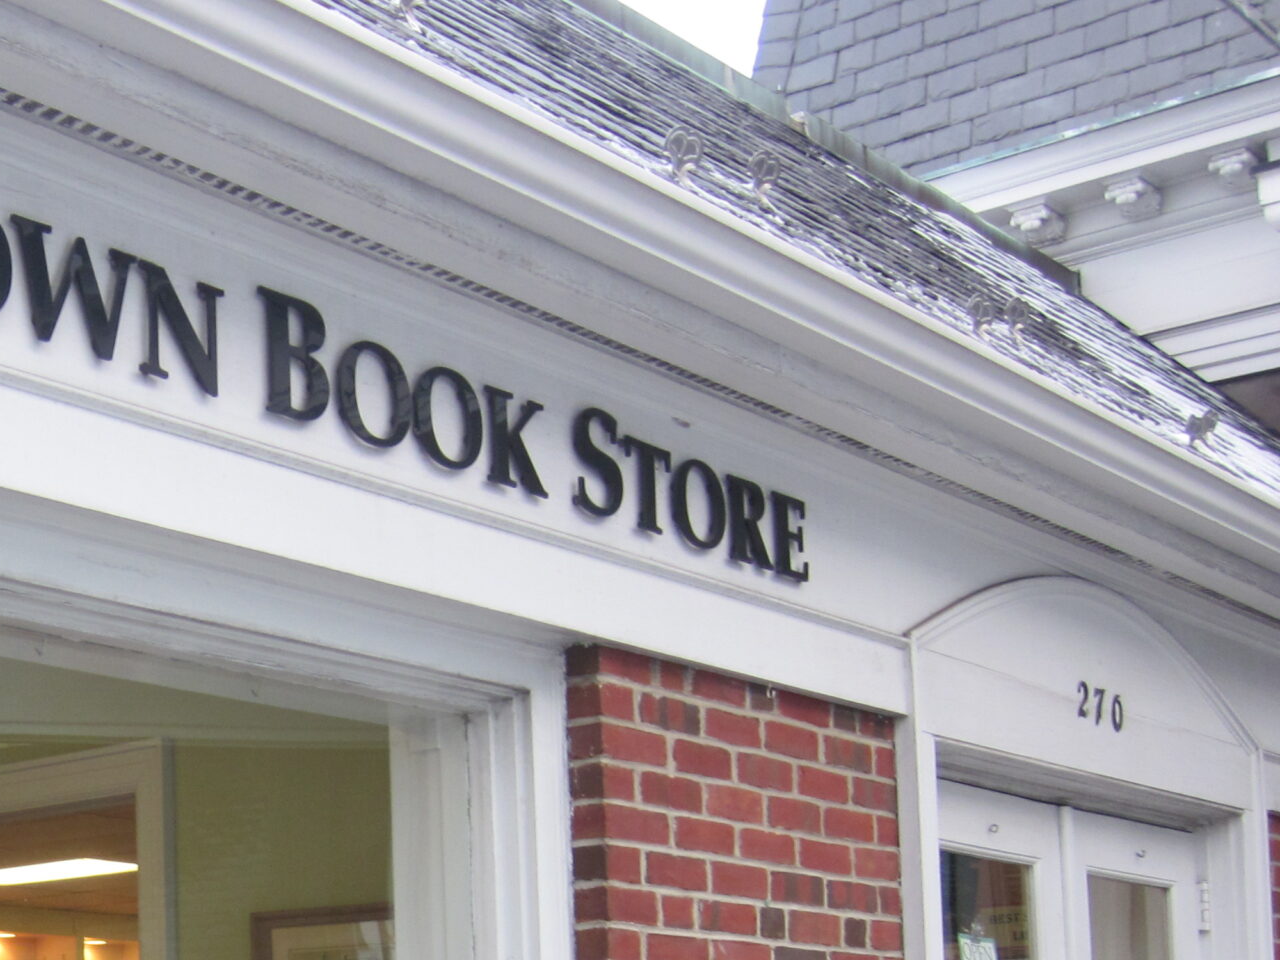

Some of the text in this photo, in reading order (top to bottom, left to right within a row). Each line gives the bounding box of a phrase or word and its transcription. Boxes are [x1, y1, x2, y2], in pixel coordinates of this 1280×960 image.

[256, 285, 549, 499] BOOK
[572, 407, 809, 583] STORE
[1077, 680, 1124, 733] 270
